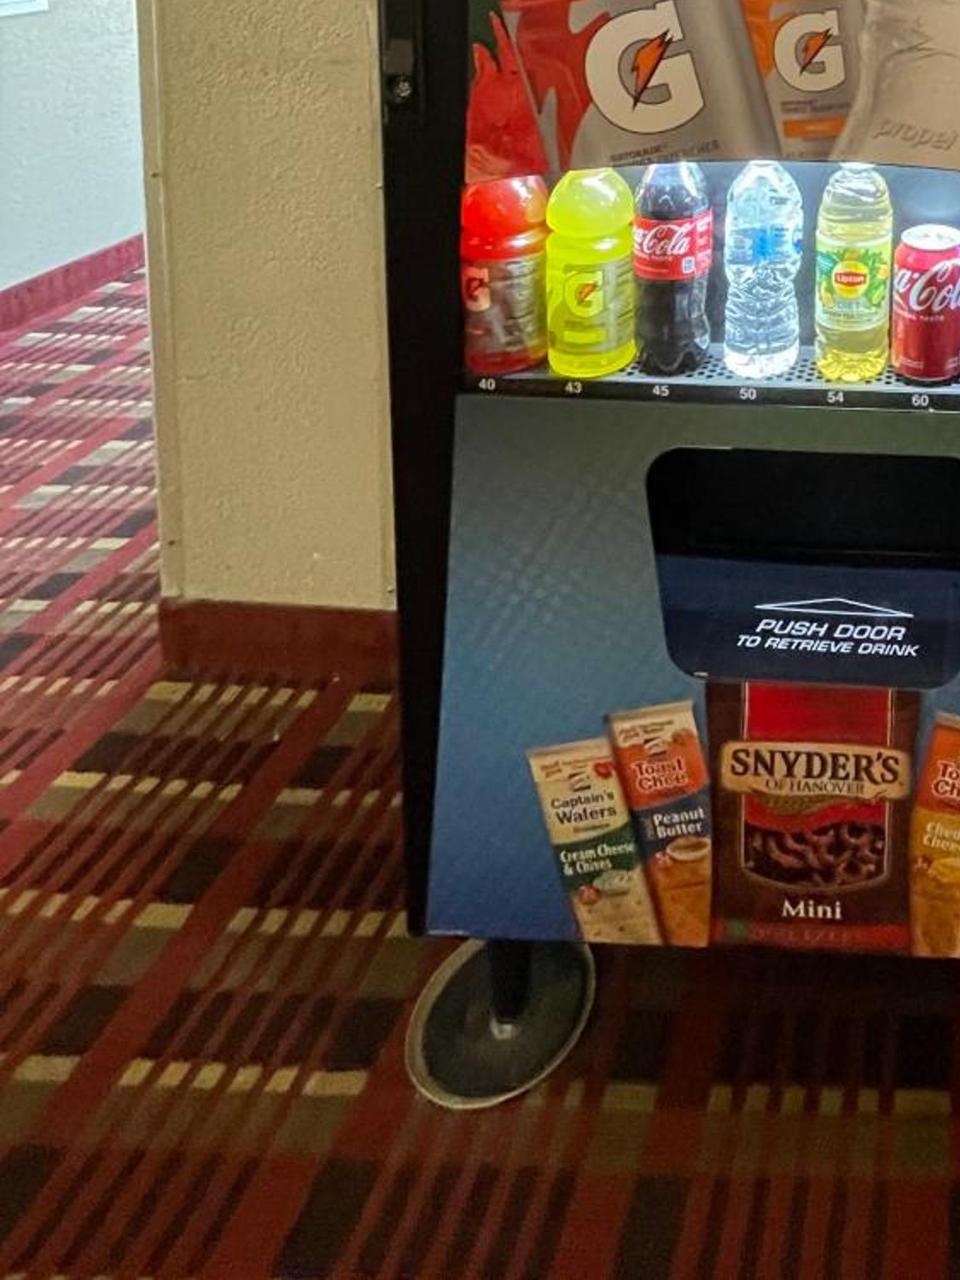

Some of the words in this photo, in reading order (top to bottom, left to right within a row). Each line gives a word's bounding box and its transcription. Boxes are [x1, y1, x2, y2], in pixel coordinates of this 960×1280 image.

[774, 10, 846, 92] G
[585, 0, 705, 134] G
[871, 120, 959, 152] propel
[836, 272, 866, 283] Lipton
[564, 271, 603, 318] G
[479, 378, 496, 391] 40
[565, 381, 582, 394] 43
[652, 384, 669, 396] 45
[739, 388, 757, 400] 50
[827, 392, 844, 403] 54
[912, 395, 929, 406] 60
[756, 619, 828, 638] PUSH
[833, 623, 906, 641] DOOR
[736, 635, 760, 648] TO
[764, 637, 852, 654] RETRIEVE
[858, 643, 919, 657] DRINK
[731, 748, 900, 785] SNYDER'S
[790, 781, 865, 795] HANOVER
[551, 790, 614, 811] Captain's
[556, 806, 617, 825] Wafers
[652, 808, 705, 827] Peanut
[656, 821, 703, 839] Butter
[560, 848, 597, 863] Cream
[597, 841, 636, 857] Cheese
[563, 862, 574, 876] &
[575, 858, 612, 872] Chives
[782, 899, 842, 920] Mini
